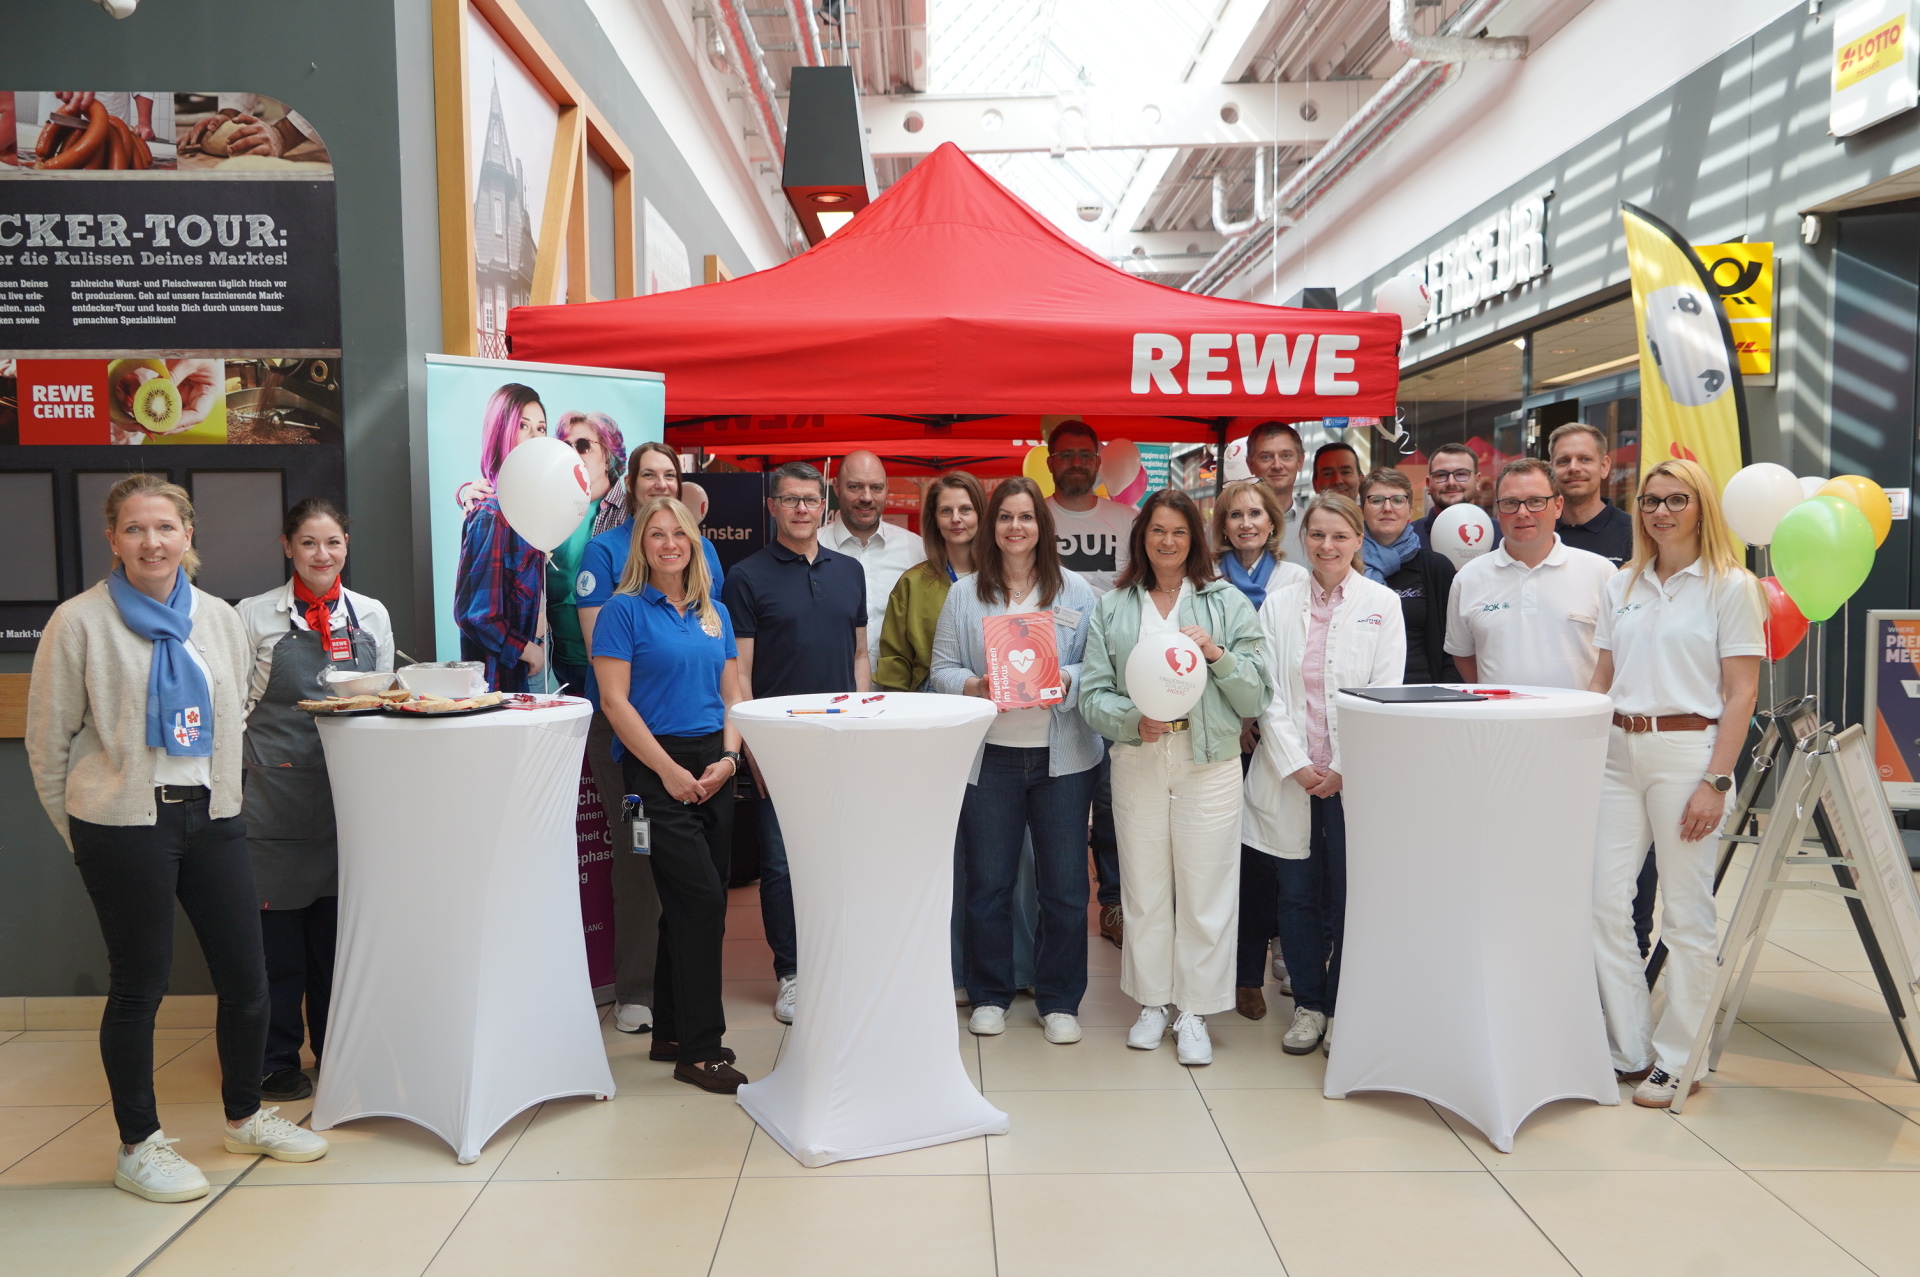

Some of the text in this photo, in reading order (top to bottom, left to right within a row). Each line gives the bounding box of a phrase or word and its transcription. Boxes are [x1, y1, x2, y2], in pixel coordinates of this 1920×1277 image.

[1858, 25, 1901, 62] LOTTO
[0, 214, 287, 247] CKER-TOUR:
[20, 251, 49, 266] die
[54, 251, 135, 266] Kulissen
[140, 251, 203, 266] Deines
[208, 251, 288, 266] Marktes!
[20, 279, 49, 288] Deines
[70, 279, 114, 288] zahlreiche
[115, 279, 143, 288] Wurst-
[143, 279, 161, 288] und
[161, 279, 217, 288] Fleischwaren
[218, 279, 248, 290] täglich
[248, 279, 273, 288] frisch
[9, 291, 24, 300] live
[25, 291, 44, 300] erle-
[71, 291, 84, 300] Ort
[84, 291, 137, 301] produzieren.
[138, 291, 155, 300] Geh
[156, 291, 170, 300] auf
[201, 291, 257, 300] faszinierende
[258, 291, 285, 300] Markt-
[24, 303, 46, 312] nach
[72, 303, 136, 312] entdecker-Tour
[137, 303, 155, 312] und
[156, 303, 180, 312] koste
[181, 303, 201, 312] Dich
[202, 303, 228, 312] durch
[260, 303, 285, 312] haus-
[15, 316, 40, 324] sowie
[72, 315, 177, 326] gemachten Spezialitäten!
[1130, 332, 1361, 397] REWE
[32, 385, 94, 402] REWE
[33, 404, 95, 419] CENTER
[1886, 635, 1920, 648] PRE
[990, 647, 1002, 703] Frauenherzen
[1001, 665, 1011, 703] im Fokus
